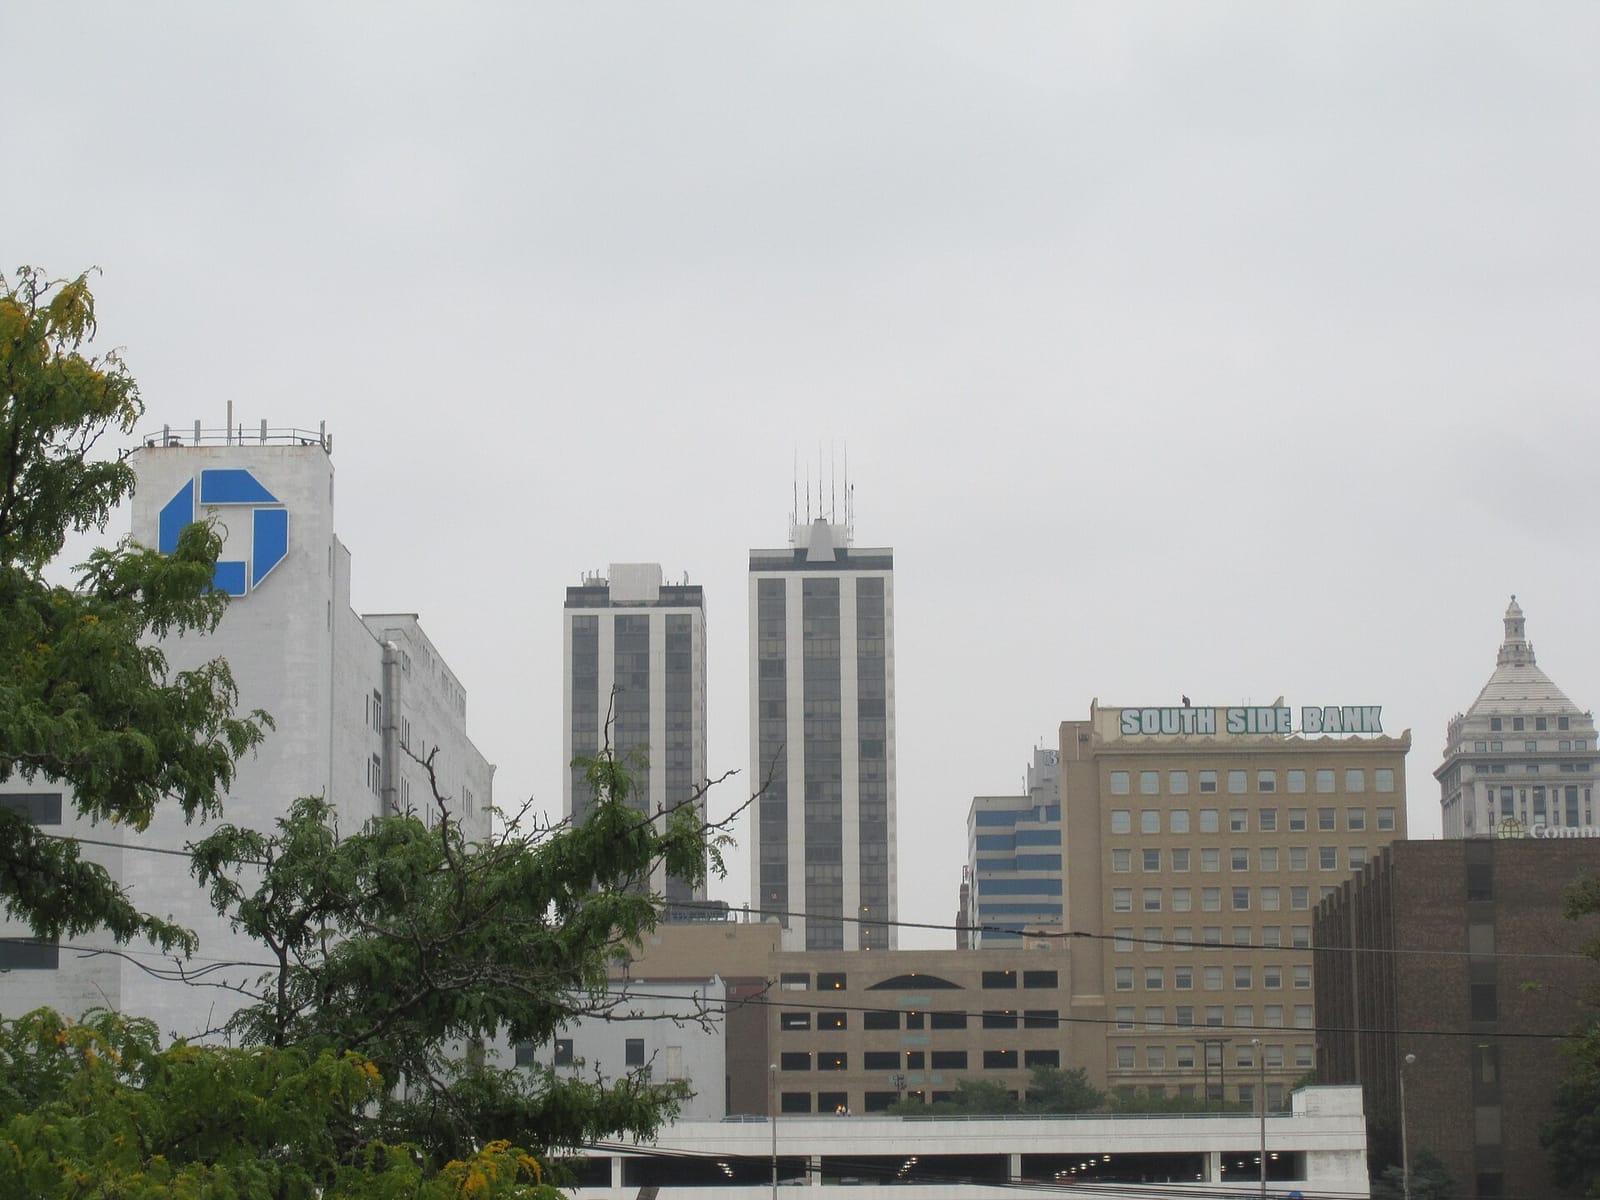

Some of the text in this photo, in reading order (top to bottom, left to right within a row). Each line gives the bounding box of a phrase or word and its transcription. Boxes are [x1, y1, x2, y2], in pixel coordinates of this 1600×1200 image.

[1120, 706, 1383, 735] SOUTH SIDE BANK
